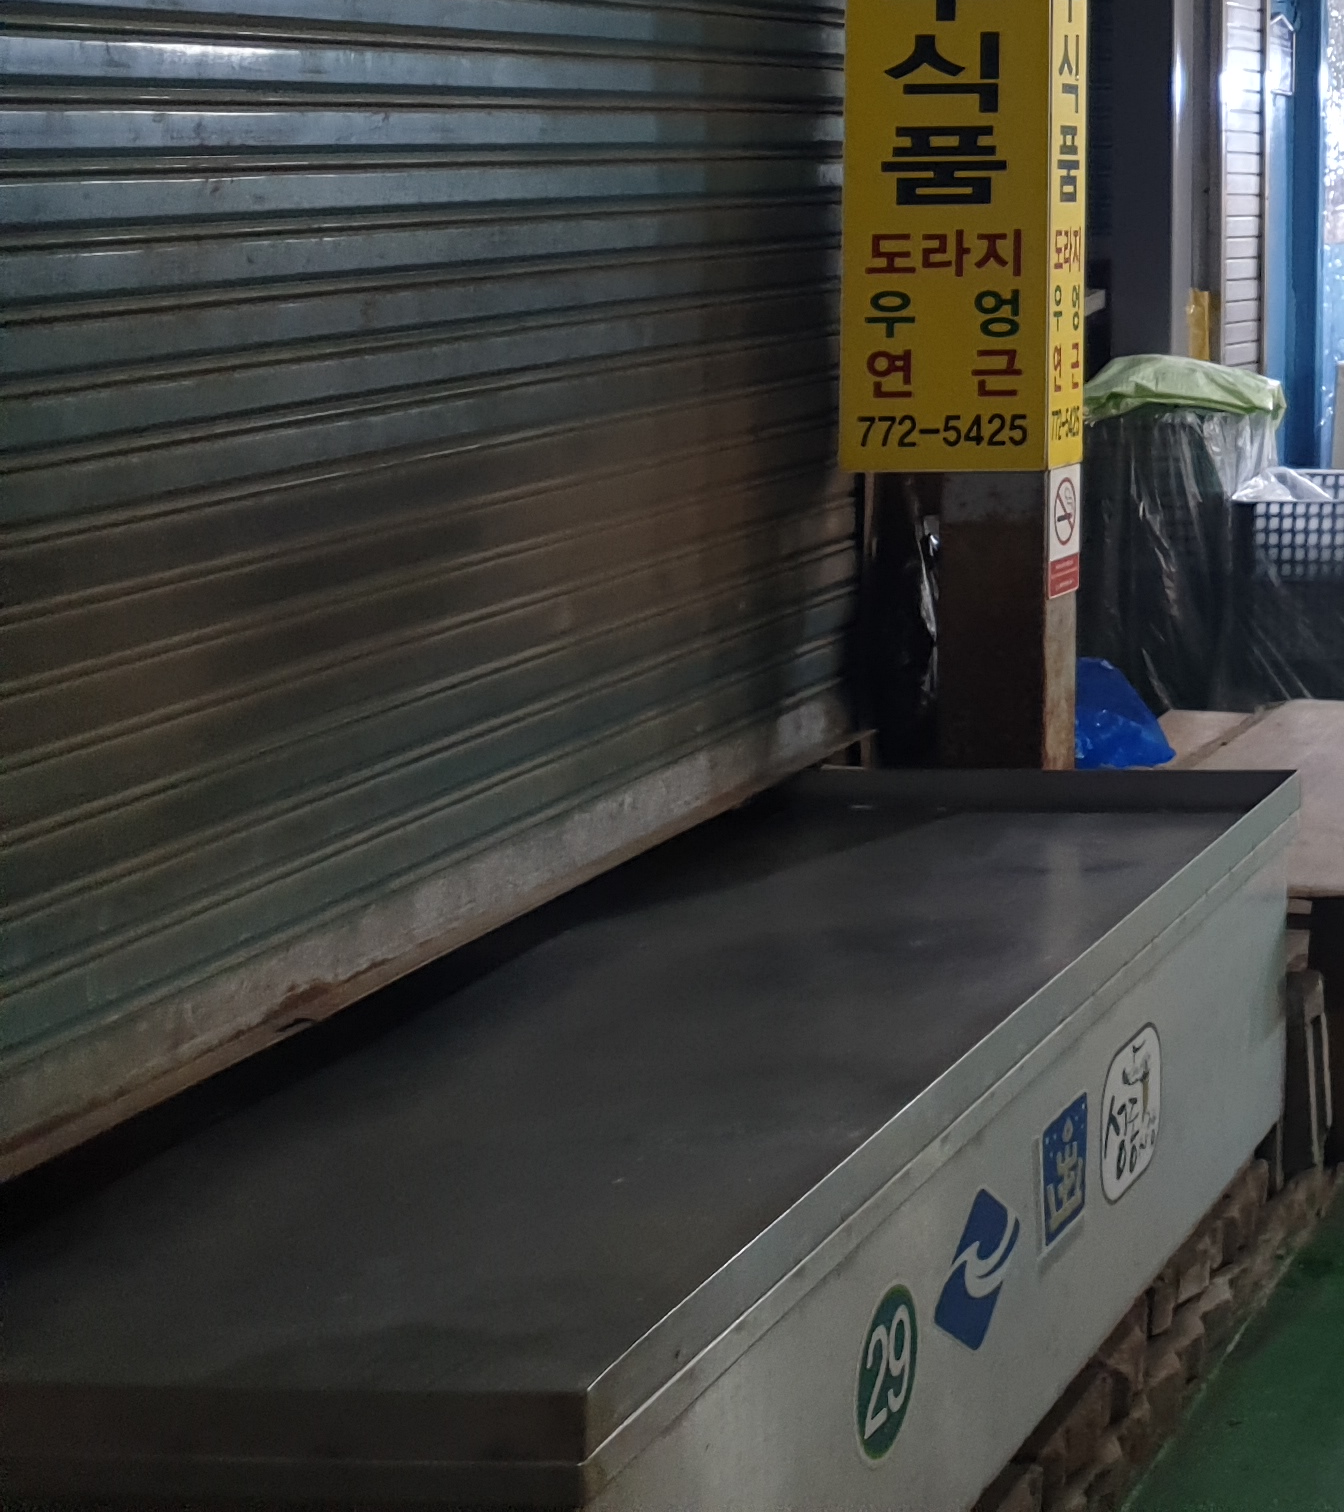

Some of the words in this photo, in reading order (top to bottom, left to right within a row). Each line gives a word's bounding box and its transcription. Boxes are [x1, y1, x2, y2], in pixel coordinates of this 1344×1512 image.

[864, 228, 1022, 277] 도라지
[1053, 226, 1082, 273] 도라지
[857, 413, 1029, 447] 772-5425
[1050, 405, 1081, 443] 772-5425
[863, 1302, 912, 1441] 29
